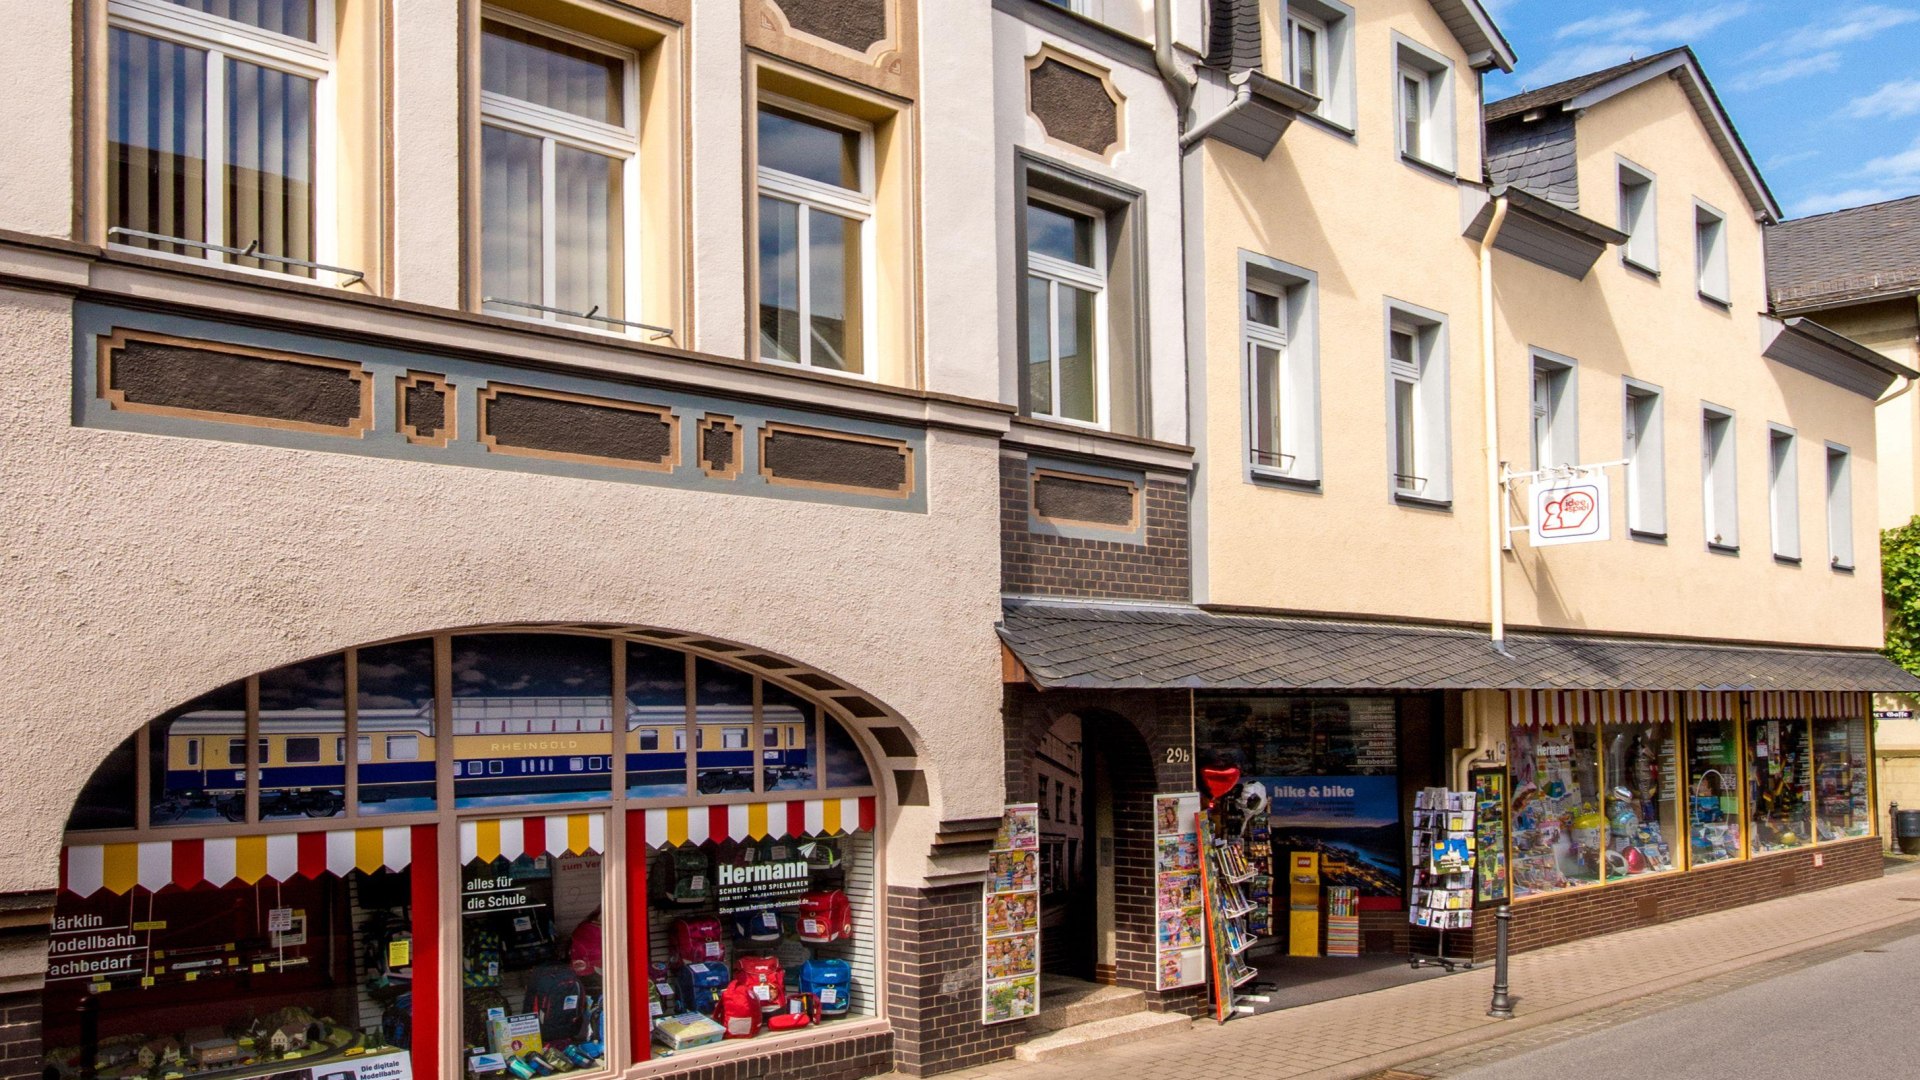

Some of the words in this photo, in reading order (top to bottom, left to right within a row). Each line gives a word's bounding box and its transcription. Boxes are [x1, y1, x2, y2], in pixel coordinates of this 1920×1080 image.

[491, 740, 578, 752] RHEINGOLD
[1536, 744, 1569, 756] Hermann
[1166, 747, 1190, 764] 29b
[1274, 785, 1306, 798] hike
[1308, 785, 1321, 798] &
[1322, 785, 1355, 798] bike
[562, 862, 583, 871] zum
[719, 861, 808, 885] Hermann
[466, 877, 495, 891] alles
[496, 876, 513, 888] für
[718, 886, 751, 896] SCHREIB-
[752, 884, 767, 892] UND
[768, 880, 809, 890] SPIELWAREN
[467, 897, 486, 910] die
[487, 893, 527, 909] Schule
[360, 1063, 373, 1073] Die
[373, 1060, 400, 1071] digitale
